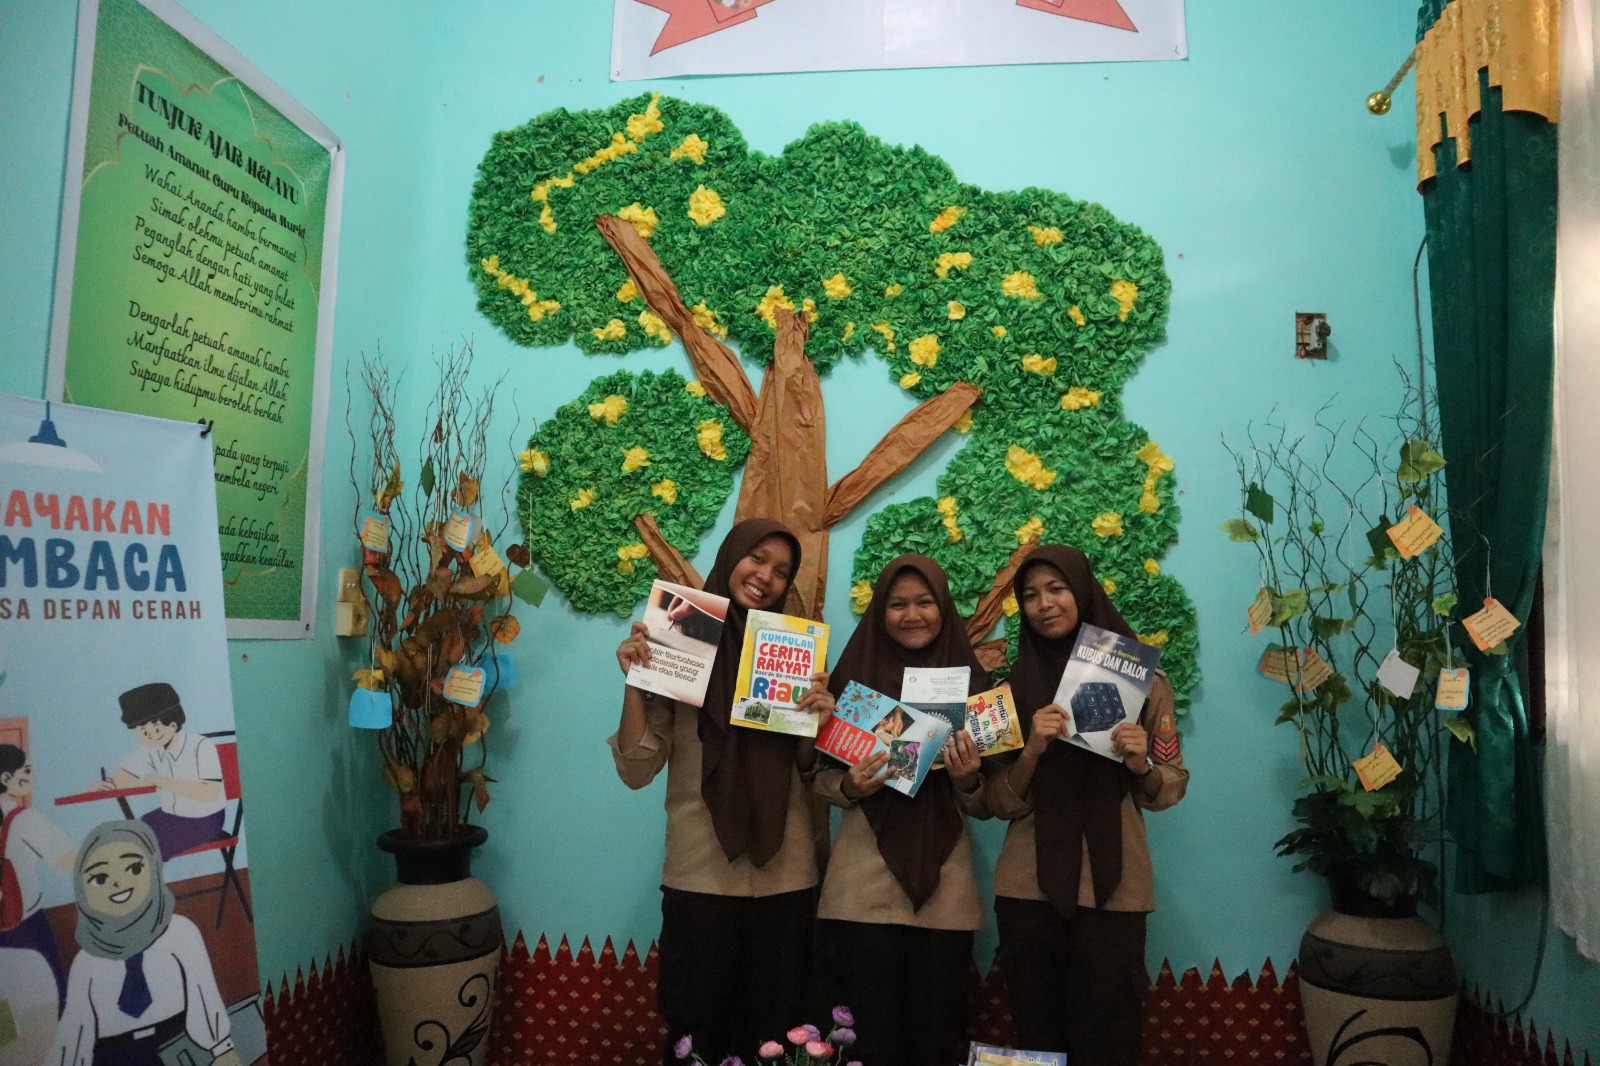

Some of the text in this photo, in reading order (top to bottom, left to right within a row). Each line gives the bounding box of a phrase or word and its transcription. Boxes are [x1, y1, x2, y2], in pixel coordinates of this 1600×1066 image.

[136, 81, 299, 204] TUNJUK AJAR MELAYU
[118, 113, 305, 239] Petuah Amanat Guru Kepada Murid
[144, 163, 183, 198] Wahai
[182, 190, 225, 222] Ananda
[226, 208, 257, 241] hamba
[150, 197, 289, 283] Simak olehmu petuah amanat
[135, 215, 296, 310] Peganglah dengan hati yang bulat
[132, 245, 294, 333] Semoga Allah memberimu rahmat
[128, 300, 290, 379] Dengarlah petuah amanah hamba
[126, 331, 290, 402] Manfaatkan ilmu dijalan Allah
[129, 360, 286, 424] Supaya hidupmu beroleh berkah
[240, 453, 261, 475] yang
[262, 454, 290, 481] terpuji
[252, 482, 279, 502] negeri
[4, 490, 170, 536] AYAKAN
[218, 516, 281, 549] ada kebajikan
[220, 542, 295, 572] egakkan keadilan
[44, 599, 121, 620] DEPAN
[132, 599, 201, 620] CERAH
[759, 642, 812, 664] CERITA
[760, 632, 814, 649] KUMPULAN
[649, 656, 679, 670] donesia
[658, 666, 674, 676] dan
[756, 656, 811, 677] RAKYAT
[1076, 645, 1149, 682] KUBUS DAN BALOK
[752, 677, 809, 705] Riau
